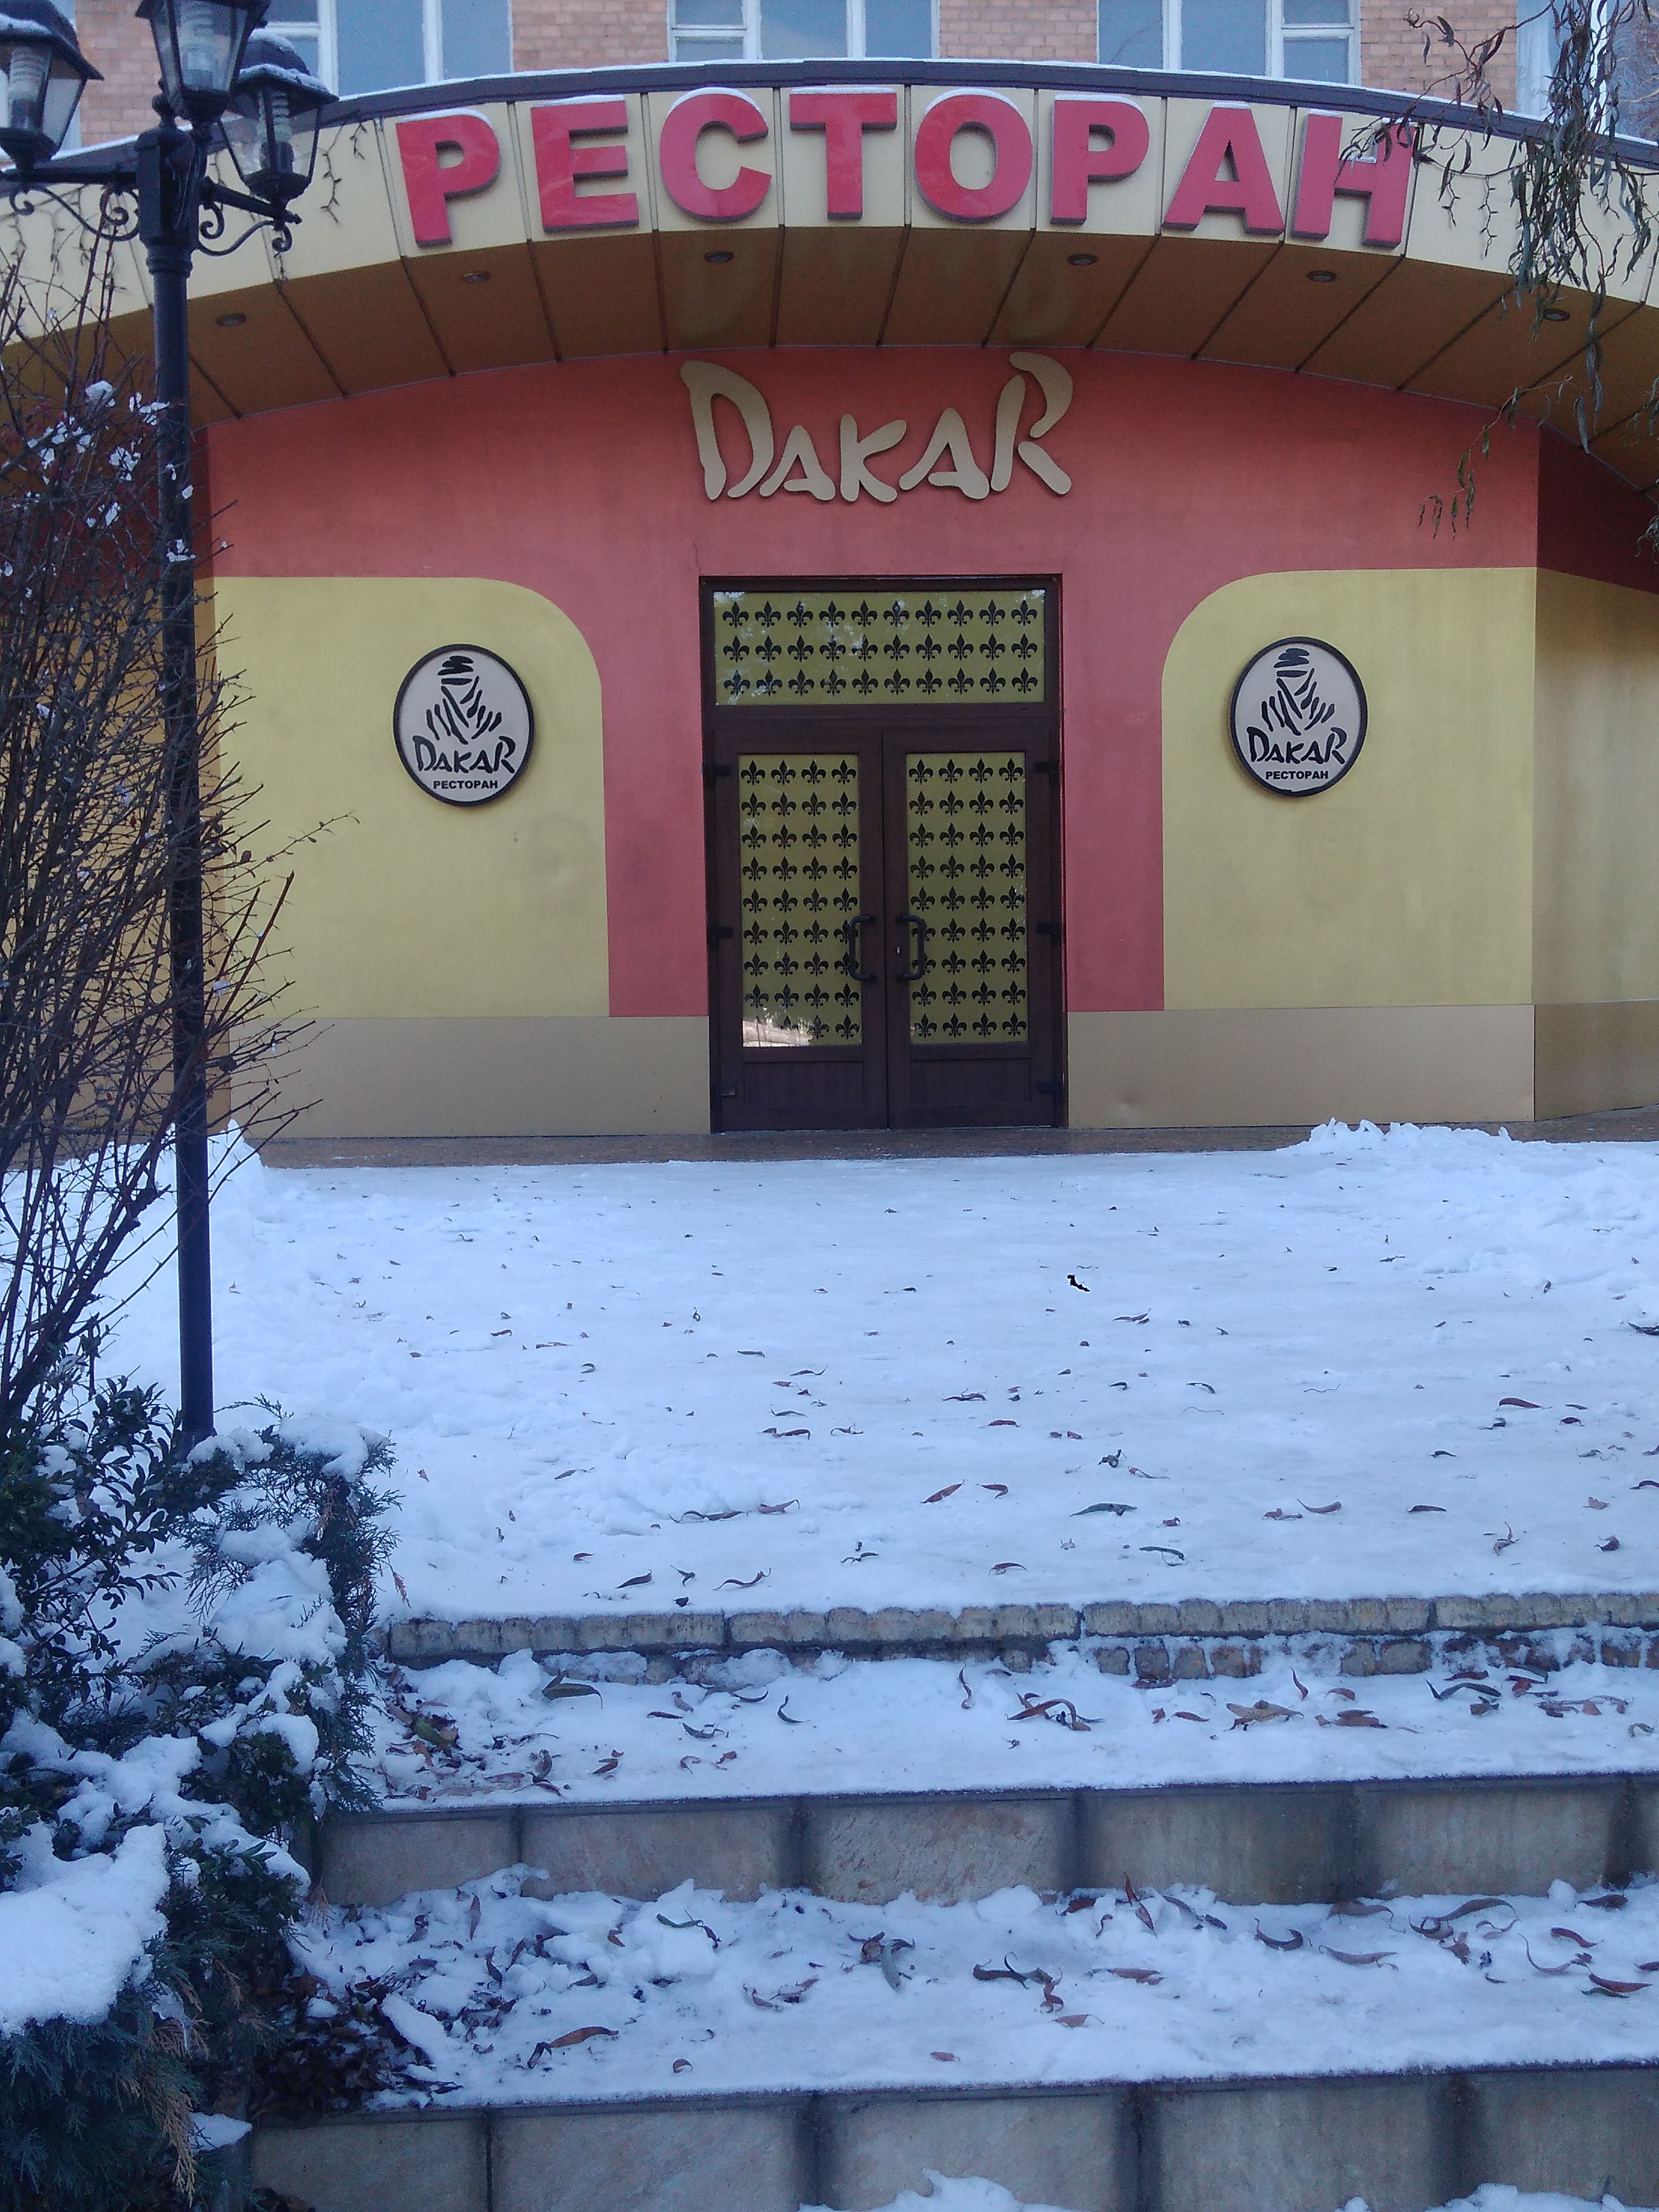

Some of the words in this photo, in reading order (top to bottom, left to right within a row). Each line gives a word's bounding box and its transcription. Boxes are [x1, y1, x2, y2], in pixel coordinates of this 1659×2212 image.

[396, 89, 1414, 248] РЕСТОРАН
[680, 352, 1074, 501] DAKAR
[412, 735, 516, 774] DAKAR
[1246, 726, 1347, 765] DAKAR
[433, 780, 498, 789] РЕСТОРАН
[1266, 771, 1329, 780] РЕСТОРАН
